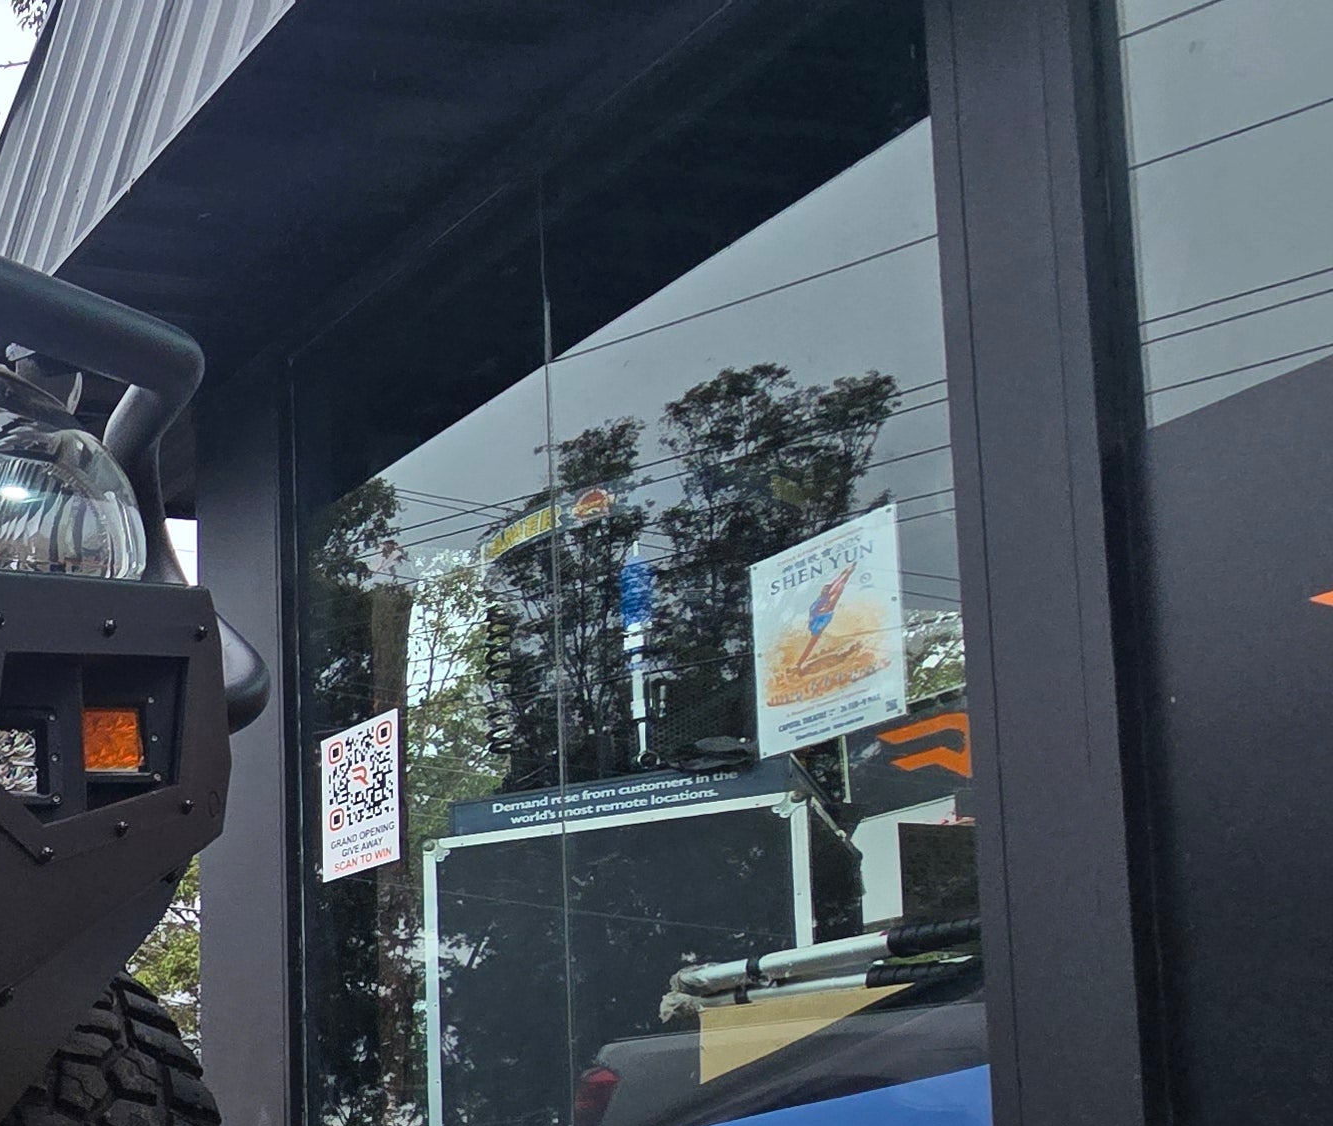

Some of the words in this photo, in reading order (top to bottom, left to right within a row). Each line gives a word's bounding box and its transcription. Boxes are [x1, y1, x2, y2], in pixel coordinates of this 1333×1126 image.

[770, 564, 824, 595] SHEN
[828, 540, 875, 570] YUN
[492, 794, 549, 814] Demand
[582, 787, 616, 802] from
[618, 776, 693, 795] customers
[695, 771, 710, 785] in
[712, 768, 739, 782] the
[510, 808, 556, 825] world's
[558, 804, 594, 819] most
[595, 796, 649, 815] remote
[650, 786, 719, 806] locations.
[330, 833, 358, 849] GRAND
[359, 821, 395, 840] OPENING
[341, 844, 359, 857] GIVE
[361, 837, 384, 851] AWAY
[334, 856, 358, 873] SCAN
[360, 852, 372, 864] TO
[374, 846, 393, 859] WIN
